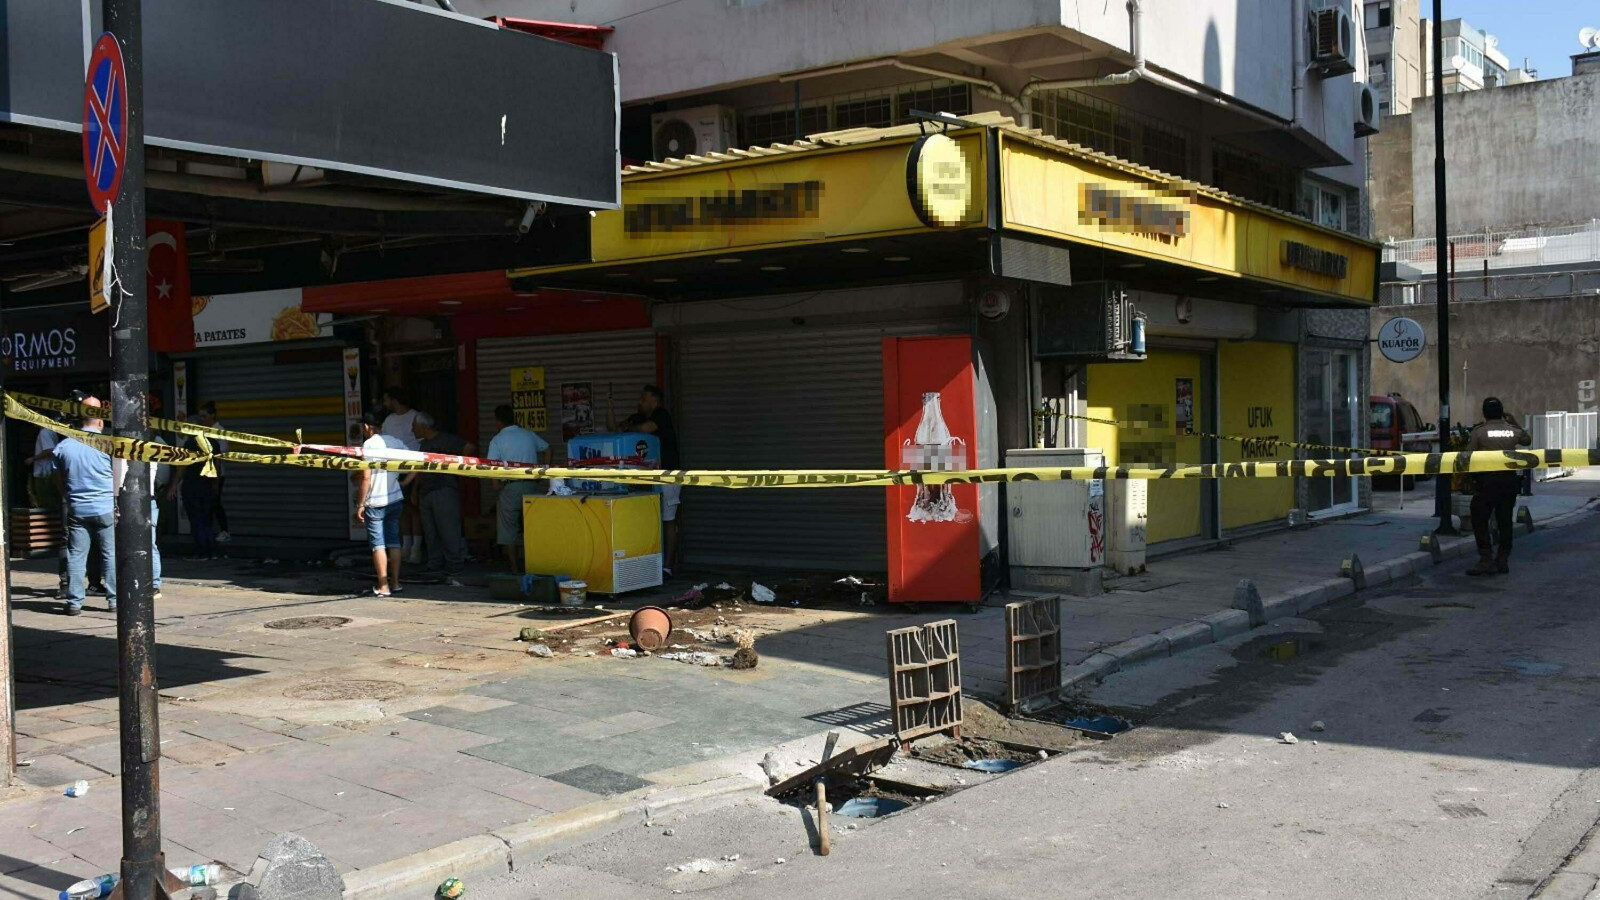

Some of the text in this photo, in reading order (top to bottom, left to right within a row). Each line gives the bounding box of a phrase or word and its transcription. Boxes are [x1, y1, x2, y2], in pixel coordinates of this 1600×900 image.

[204, 328, 246, 342] PATATES
[1382, 337, 1419, 349] KUAFÖR
[15, 356, 76, 371] EQUIPMENT
[513, 391, 545, 408] Satılık
[1247, 407, 1273, 428] UFUK
[1241, 435, 1279, 459] MARKET
